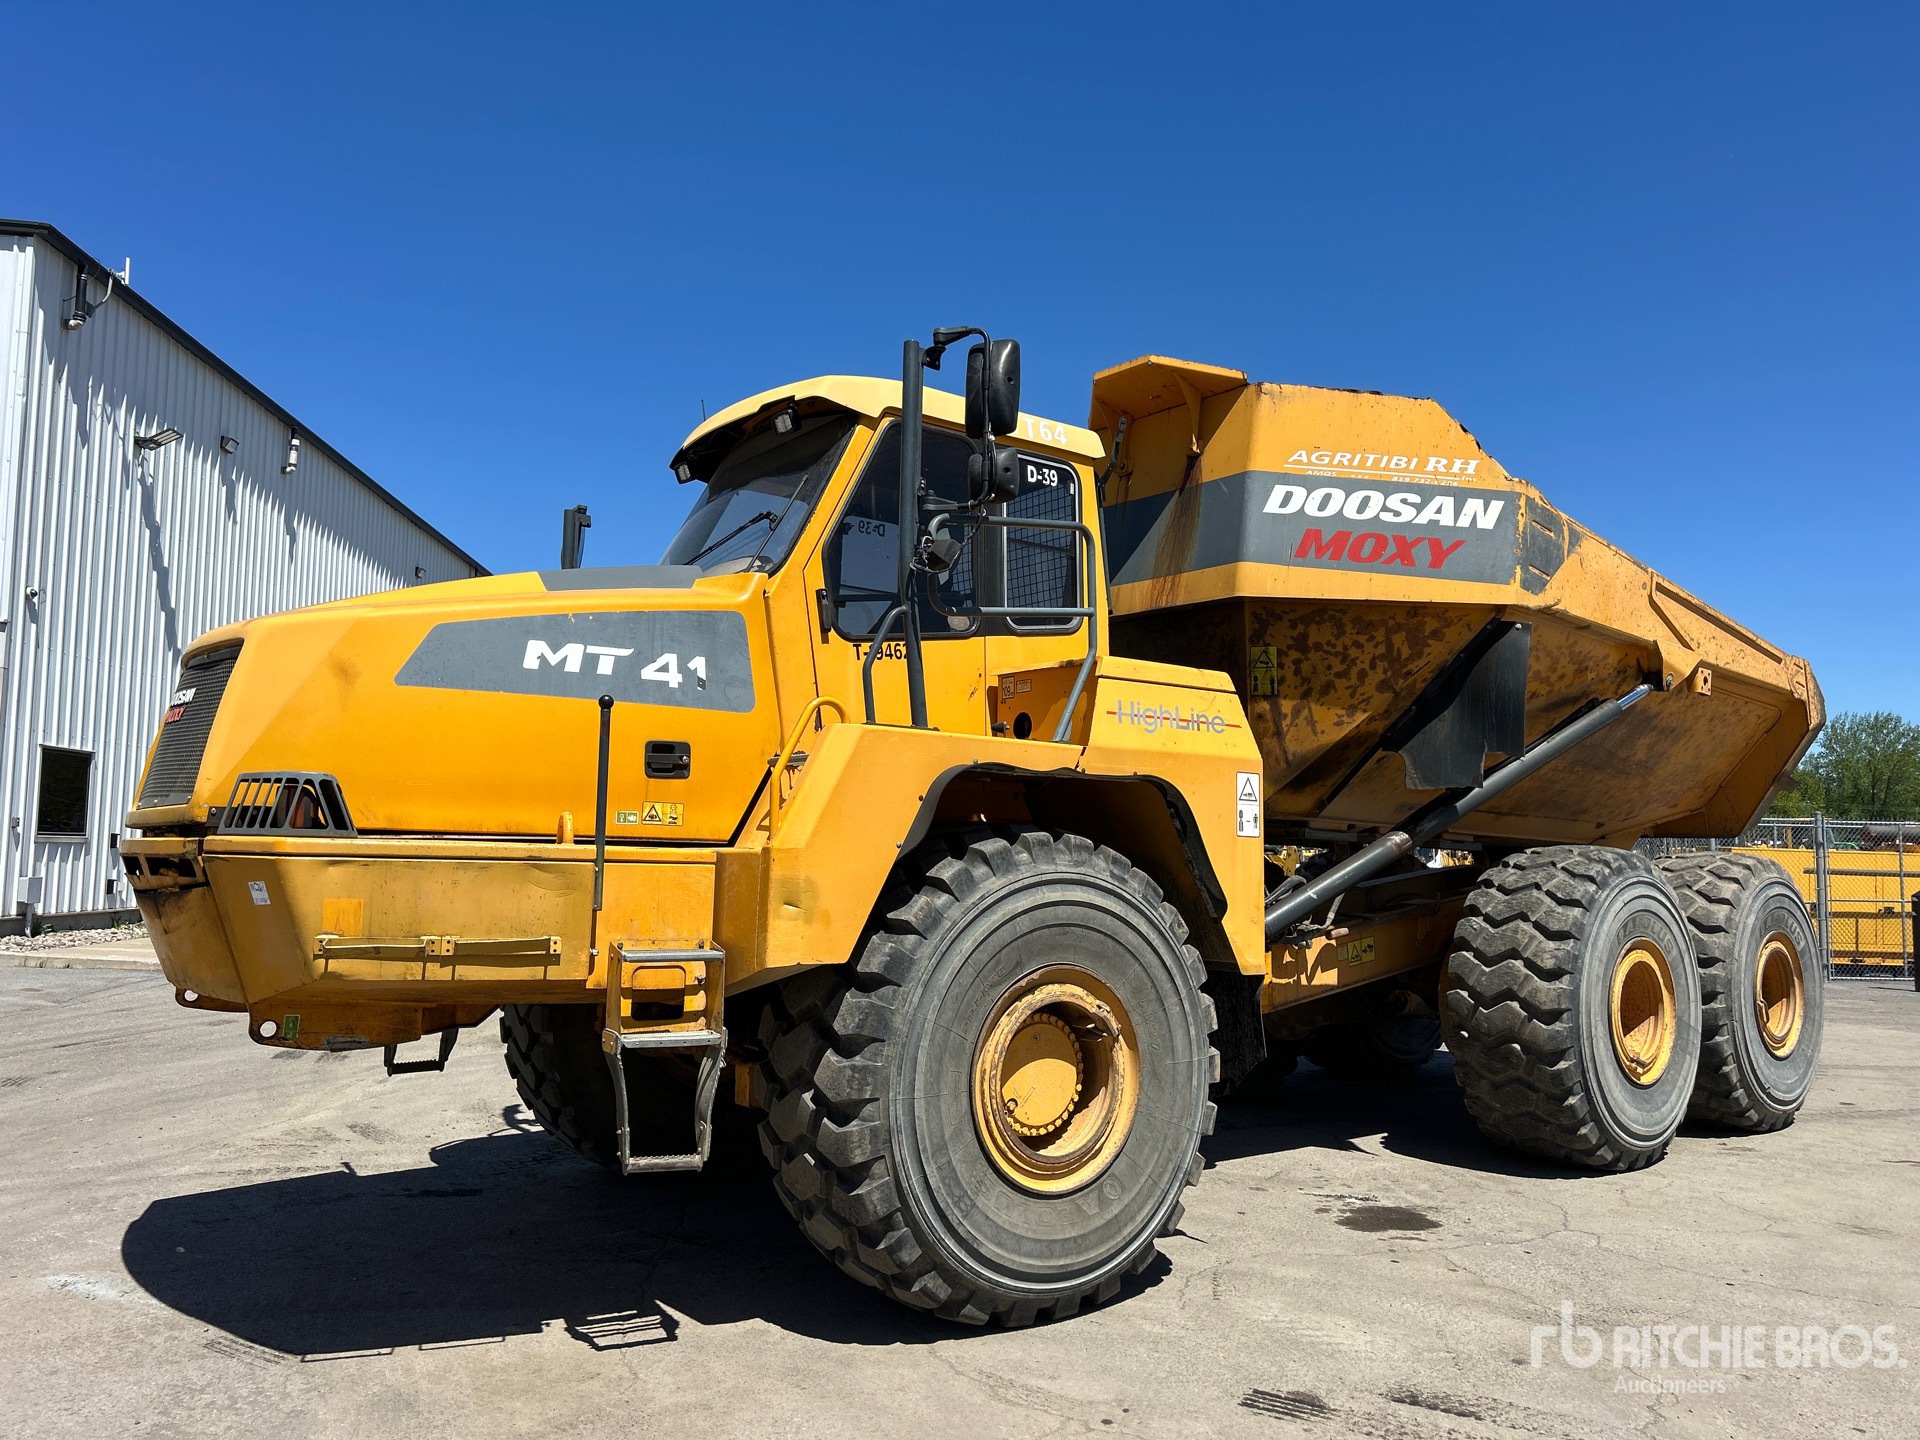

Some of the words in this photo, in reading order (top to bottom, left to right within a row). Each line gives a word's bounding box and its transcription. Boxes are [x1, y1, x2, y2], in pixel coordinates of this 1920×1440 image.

[1026, 465, 1058, 487] D-39
[1288, 450, 1419, 471] AGRITIBI
[1424, 456, 1481, 475] RH
[1262, 484, 1506, 530] DOOSAN
[1293, 527, 1467, 569] MOXY
[522, 639, 635, 676] MT
[640, 652, 707, 691] 41
[1117, 699, 1226, 734] HighLine
